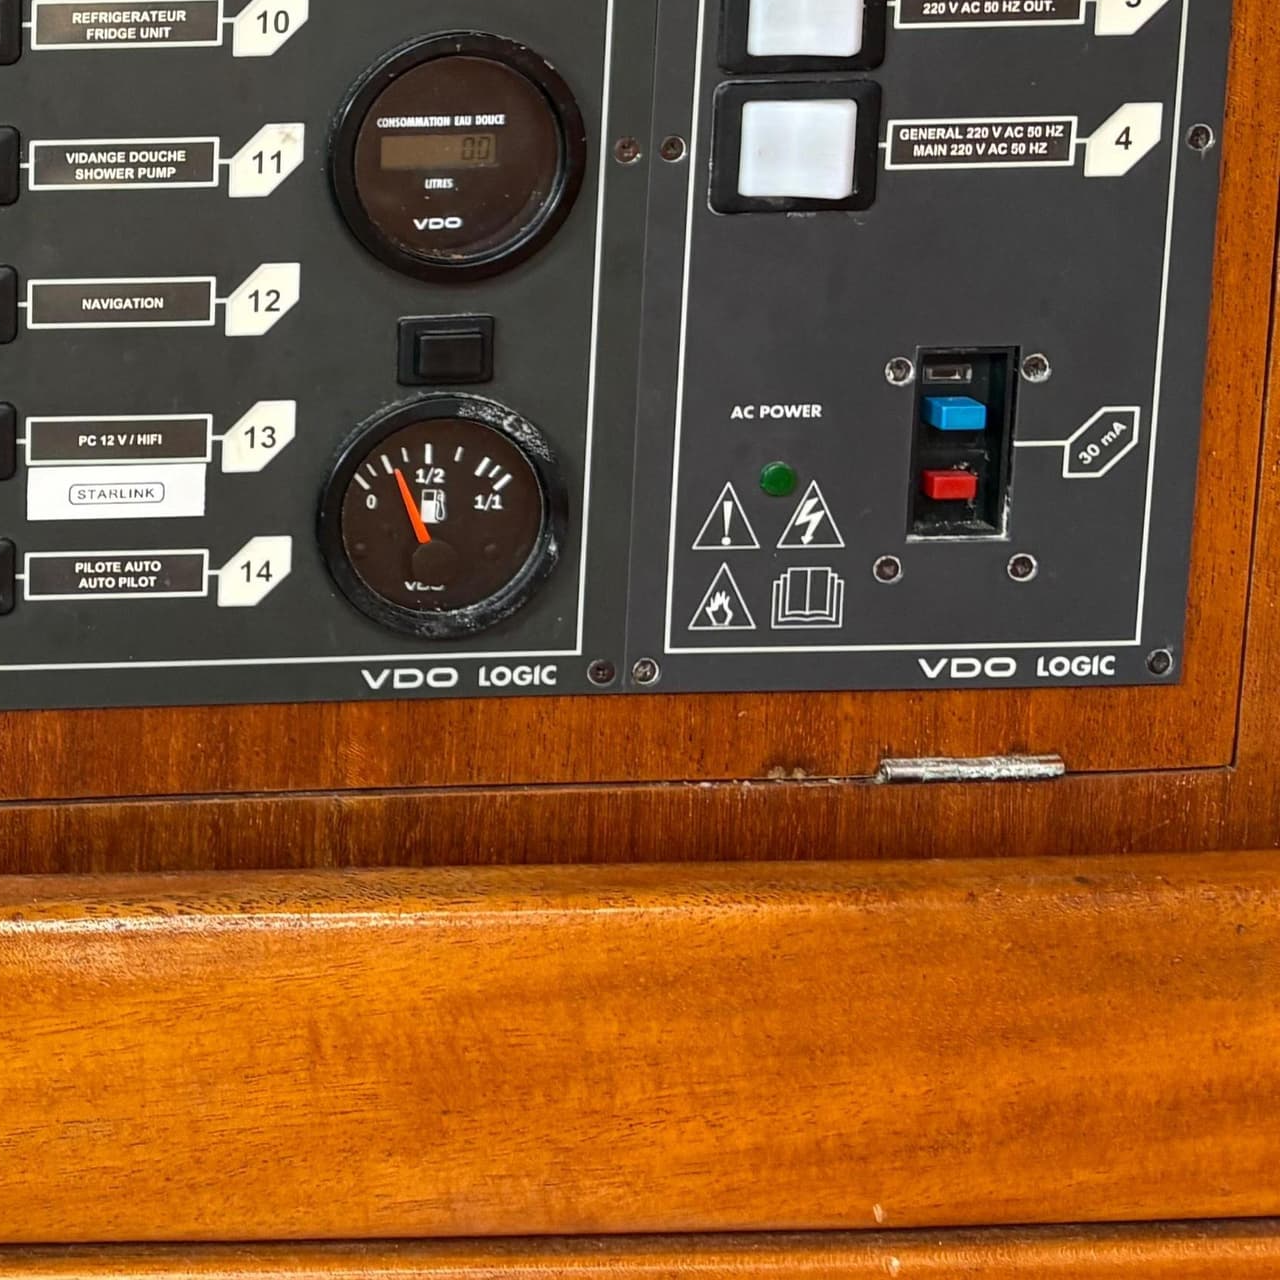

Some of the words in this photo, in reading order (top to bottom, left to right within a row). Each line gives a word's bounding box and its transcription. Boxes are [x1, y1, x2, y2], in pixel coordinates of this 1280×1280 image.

[72, 10, 186, 24] REFRIGERATEUR
[256, 10, 290, 34] 10
[86, 28, 136, 40] FRIDGE
[140, 27, 171, 39] UNIT
[377, 116, 450, 128] CONSOMMATION
[455, 115, 471, 126] EAU
[476, 114, 505, 125] DOUCE
[1115, 126, 1132, 150] 4
[66, 152, 126, 164] VIDANGE
[129, 150, 186, 162] DOUCHE
[252, 151, 282, 174] 11
[75, 168, 134, 180] SHOWER
[138, 167, 176, 179] PUMP
[425, 178, 454, 189] LITRES
[414, 218, 462, 230] VDO
[82, 298, 164, 310] NAVIGATION
[248, 290, 280, 312] 12
[730, 405, 754, 419] AC
[759, 404, 822, 419] POWER
[244, 426, 276, 448] 13
[416, 469, 445, 484] 1/2
[77, 488, 155, 500] STARLINK
[366, 495, 376, 509] 0
[474, 495, 502, 510] 1/1
[75, 561, 121, 573] PILOTE
[125, 561, 161, 572] AUTO
[241, 560, 272, 582] 14
[79, 577, 115, 588] AUTO
[119, 576, 156, 587] PILOT
[919, 658, 1017, 678] VDO
[1037, 655, 1116, 676] LOGIC
[362, 667, 458, 689] VDO
[478, 665, 557, 686] LOGIC
